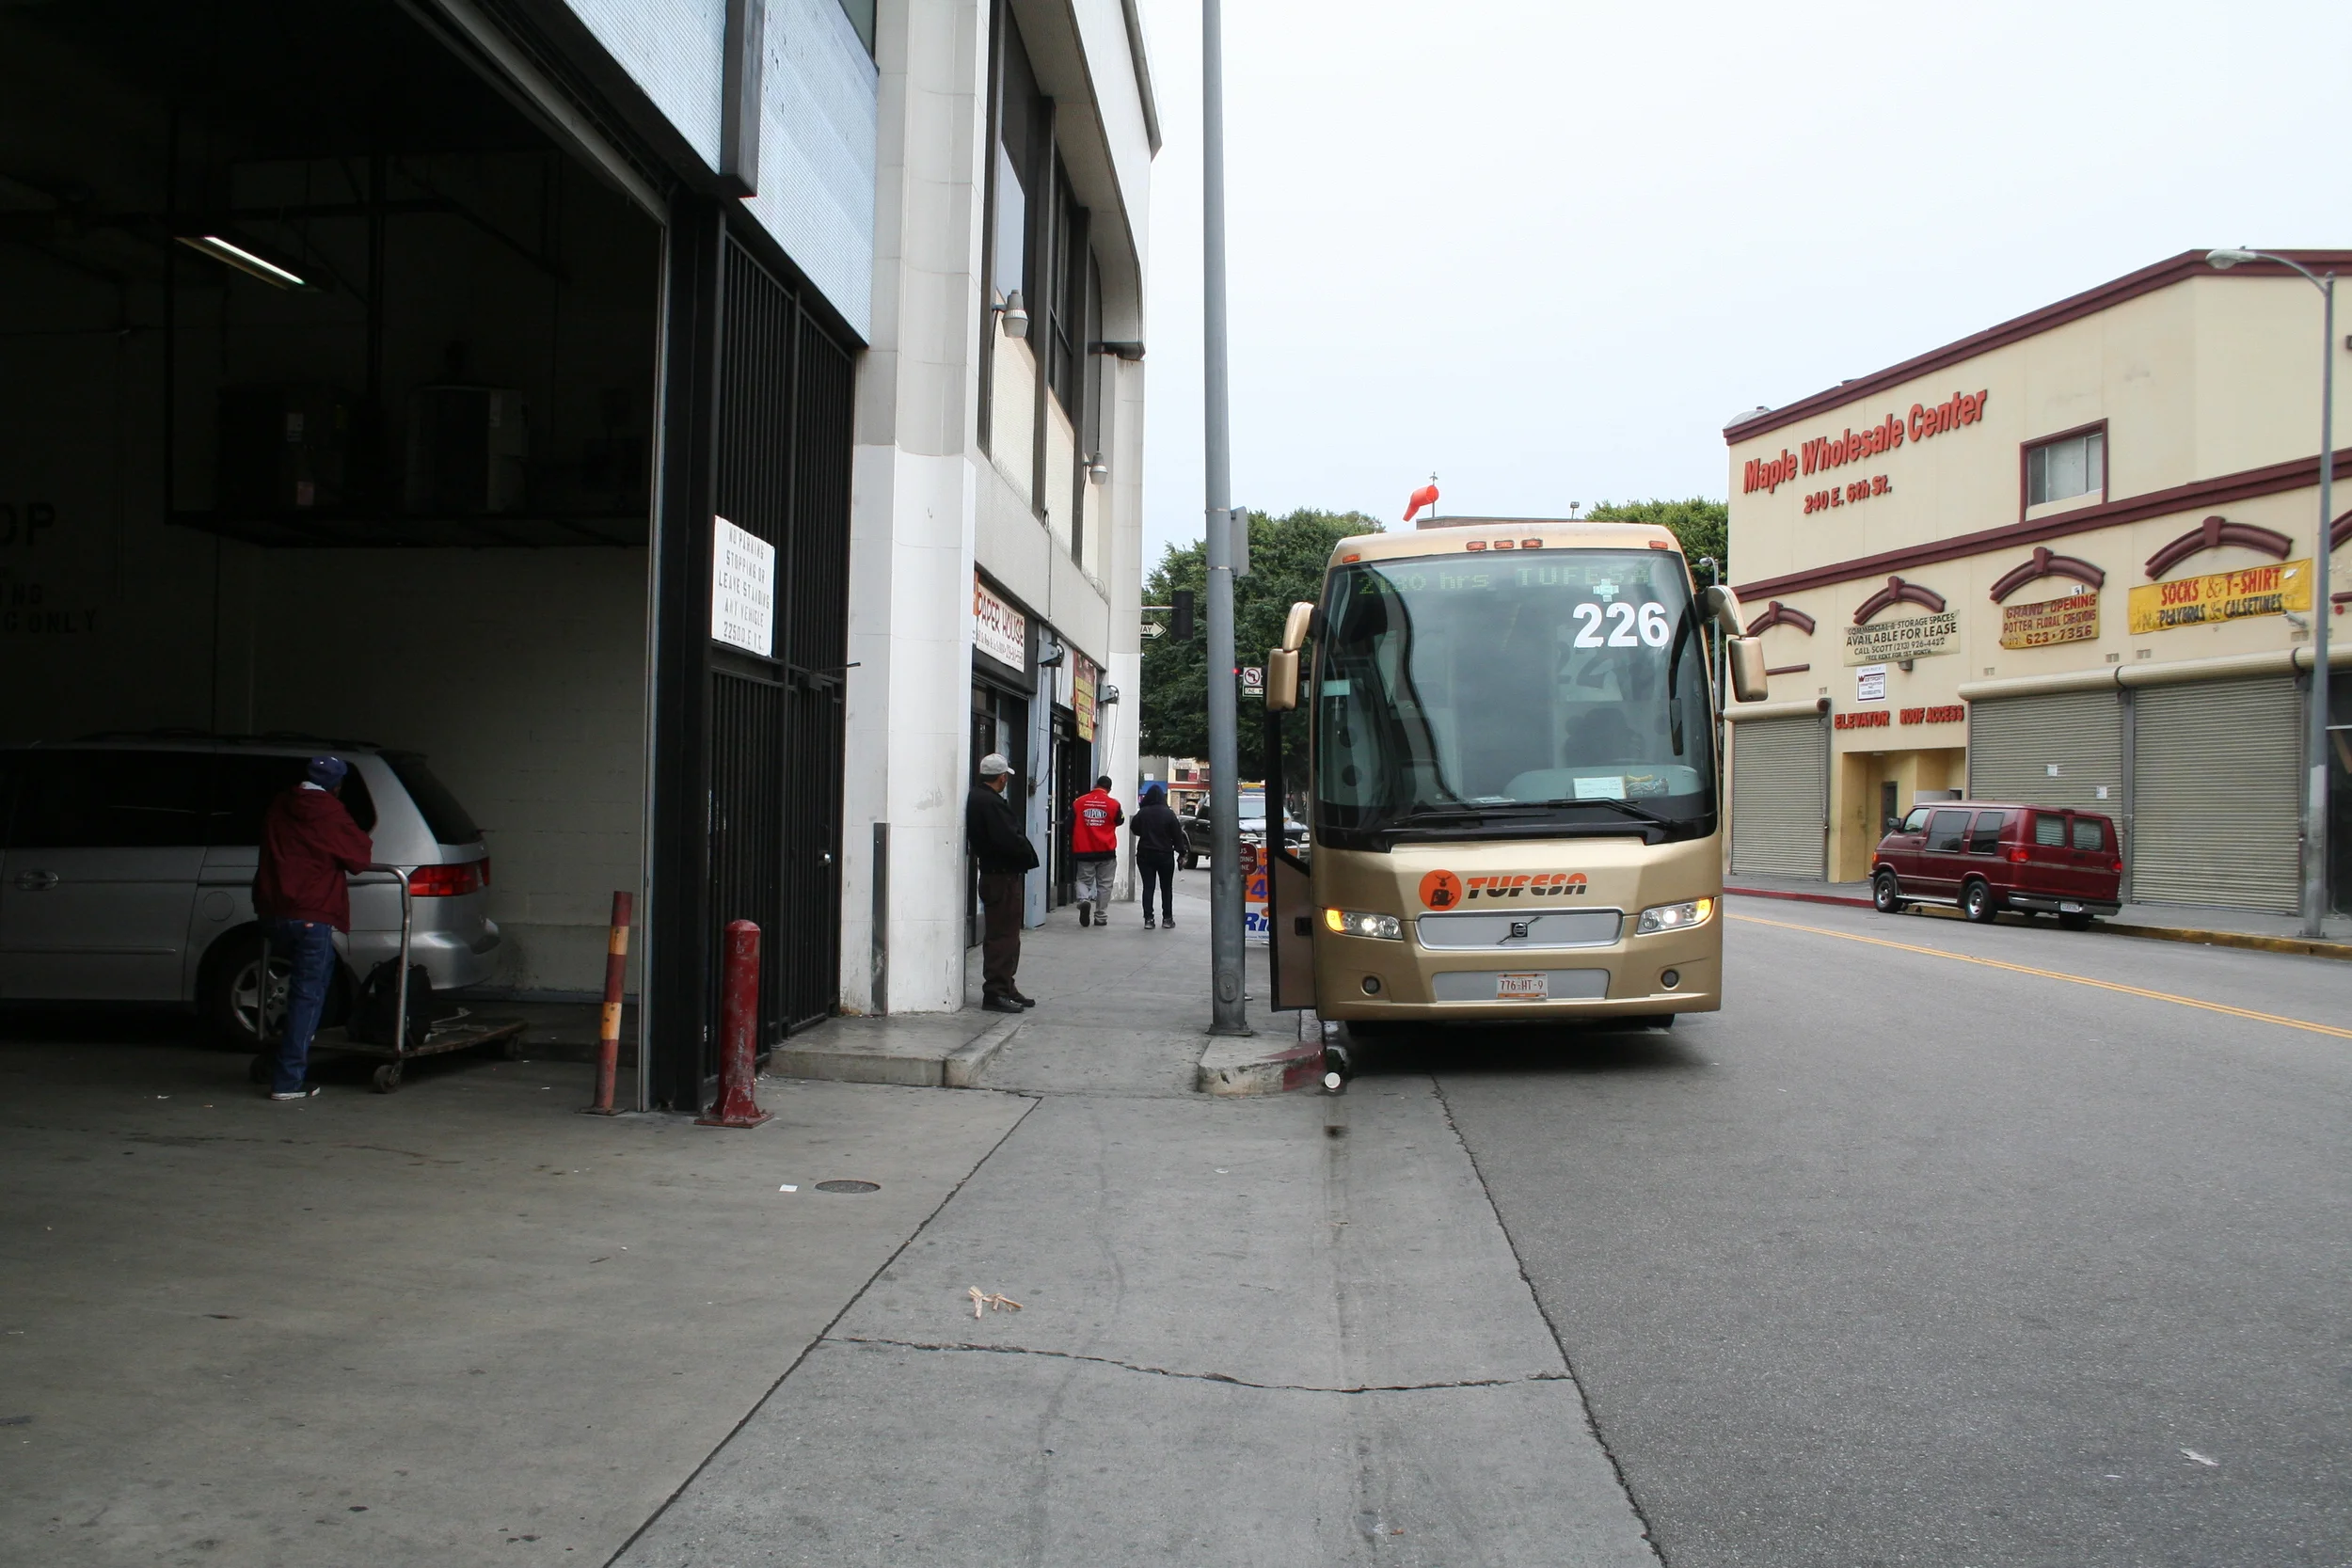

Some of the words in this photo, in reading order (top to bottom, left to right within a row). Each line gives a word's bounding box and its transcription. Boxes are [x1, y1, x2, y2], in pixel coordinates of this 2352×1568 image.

[1743, 449, 1797, 495] Maple
[1801, 413, 1903, 476] Wholesale
[1907, 388, 1987, 442] Center
[1804, 490, 1829, 515] 240
[1831, 487, 1844, 507] E.
[1846, 479, 1870, 503] 6th
[1871, 474, 1892, 496] St.
[729, 527, 737, 545] NO
[739, 531, 764, 561] PARKING
[726, 549, 756, 579] STOPPING
[758, 566, 765, 584] OR
[1439, 571, 1490, 591] hrs
[1518, 566, 1649, 587] TUFESA
[719, 569, 740, 594] LEAVE
[742, 581, 771, 610] STANDING
[2161, 578, 2199, 606] SOCKS
[2225, 567, 2281, 596] T-SHIRT
[724, 597, 738, 617] ANY
[740, 603, 764, 628] VEHICLE
[1897, 617, 1928, 629] STORAGE
[1929, 612, 1955, 624] SPACES
[2006, 603, 2043, 619] GRAND
[2050, 594, 2096, 612] OPENING
[1002, 605, 1024, 647] HOUSE
[1573, 602, 1670, 648] 226
[1846, 631, 1898, 647] AVAILABLE
[1899, 627, 1921, 640] FOR
[1923, 622, 1957, 638] LEASE
[1854, 646, 1869, 656] CALL
[1871, 643, 1892, 654] SCOTT
[1878, 652, 1892, 660] RENT
[1913, 648, 1931, 657] MONTH
[1835, 710, 1890, 730] ELEVATOR
[1899, 708, 1925, 724] ROOF
[1926, 705, 1964, 723] ACCESS
[1467, 872, 1588, 899] TUFESA
